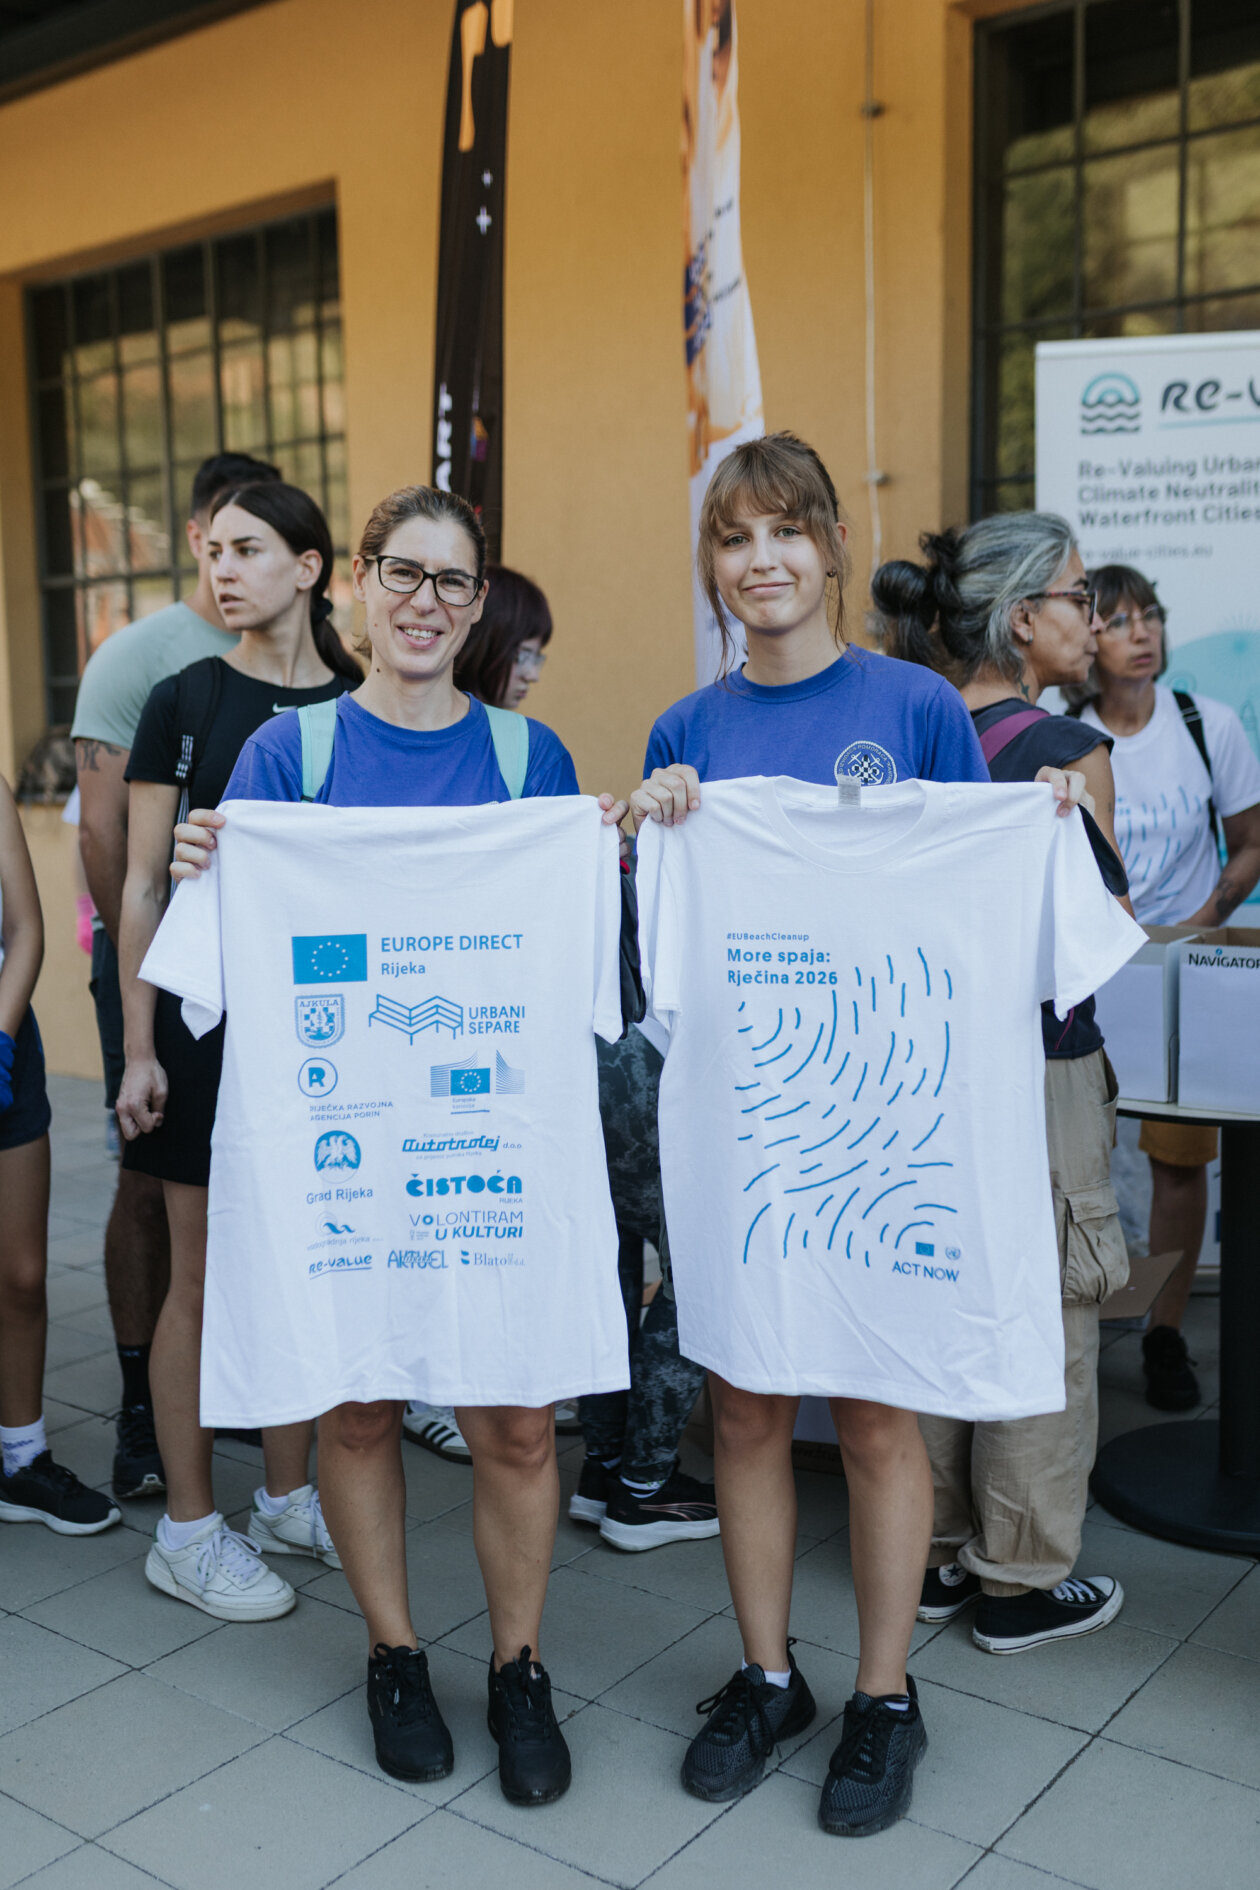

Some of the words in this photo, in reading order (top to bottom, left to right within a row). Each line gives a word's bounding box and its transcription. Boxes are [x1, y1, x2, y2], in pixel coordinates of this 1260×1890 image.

[1078, 457, 1197, 478] Re-Valuing
[1079, 485, 1159, 504] Climate
[1080, 507, 1195, 527] Waterfront
[381, 936, 454, 952] EUROPE
[459, 934, 523, 950] DIRECT
[726, 932, 810, 942] #EUBeachCleanup
[727, 948, 772, 963] More
[777, 948, 831, 966] spaja:
[381, 961, 426, 978] Rijeka
[727, 970, 789, 986] Rječina
[795, 971, 838, 985] 2026
[299, 999, 339, 1008] AJKULA
[469, 1005, 525, 1020] URBANI
[469, 1020, 520, 1034] SEPARE
[347, 1101, 394, 1110] RAZVOJNA
[310, 1113, 351, 1121] AGENCIJA
[354, 1111, 380, 1119] PORIN
[405, 1169, 522, 1197] ČISTOĆA
[306, 1189, 332, 1205] Grad
[336, 1187, 373, 1203] Rijeka
[409, 1210, 523, 1227] VOLONTIRAM
[435, 1228, 448, 1240] U
[452, 1226, 523, 1239] KULTURI
[892, 1260, 921, 1276] ACT
[923, 1265, 960, 1283] NOW
